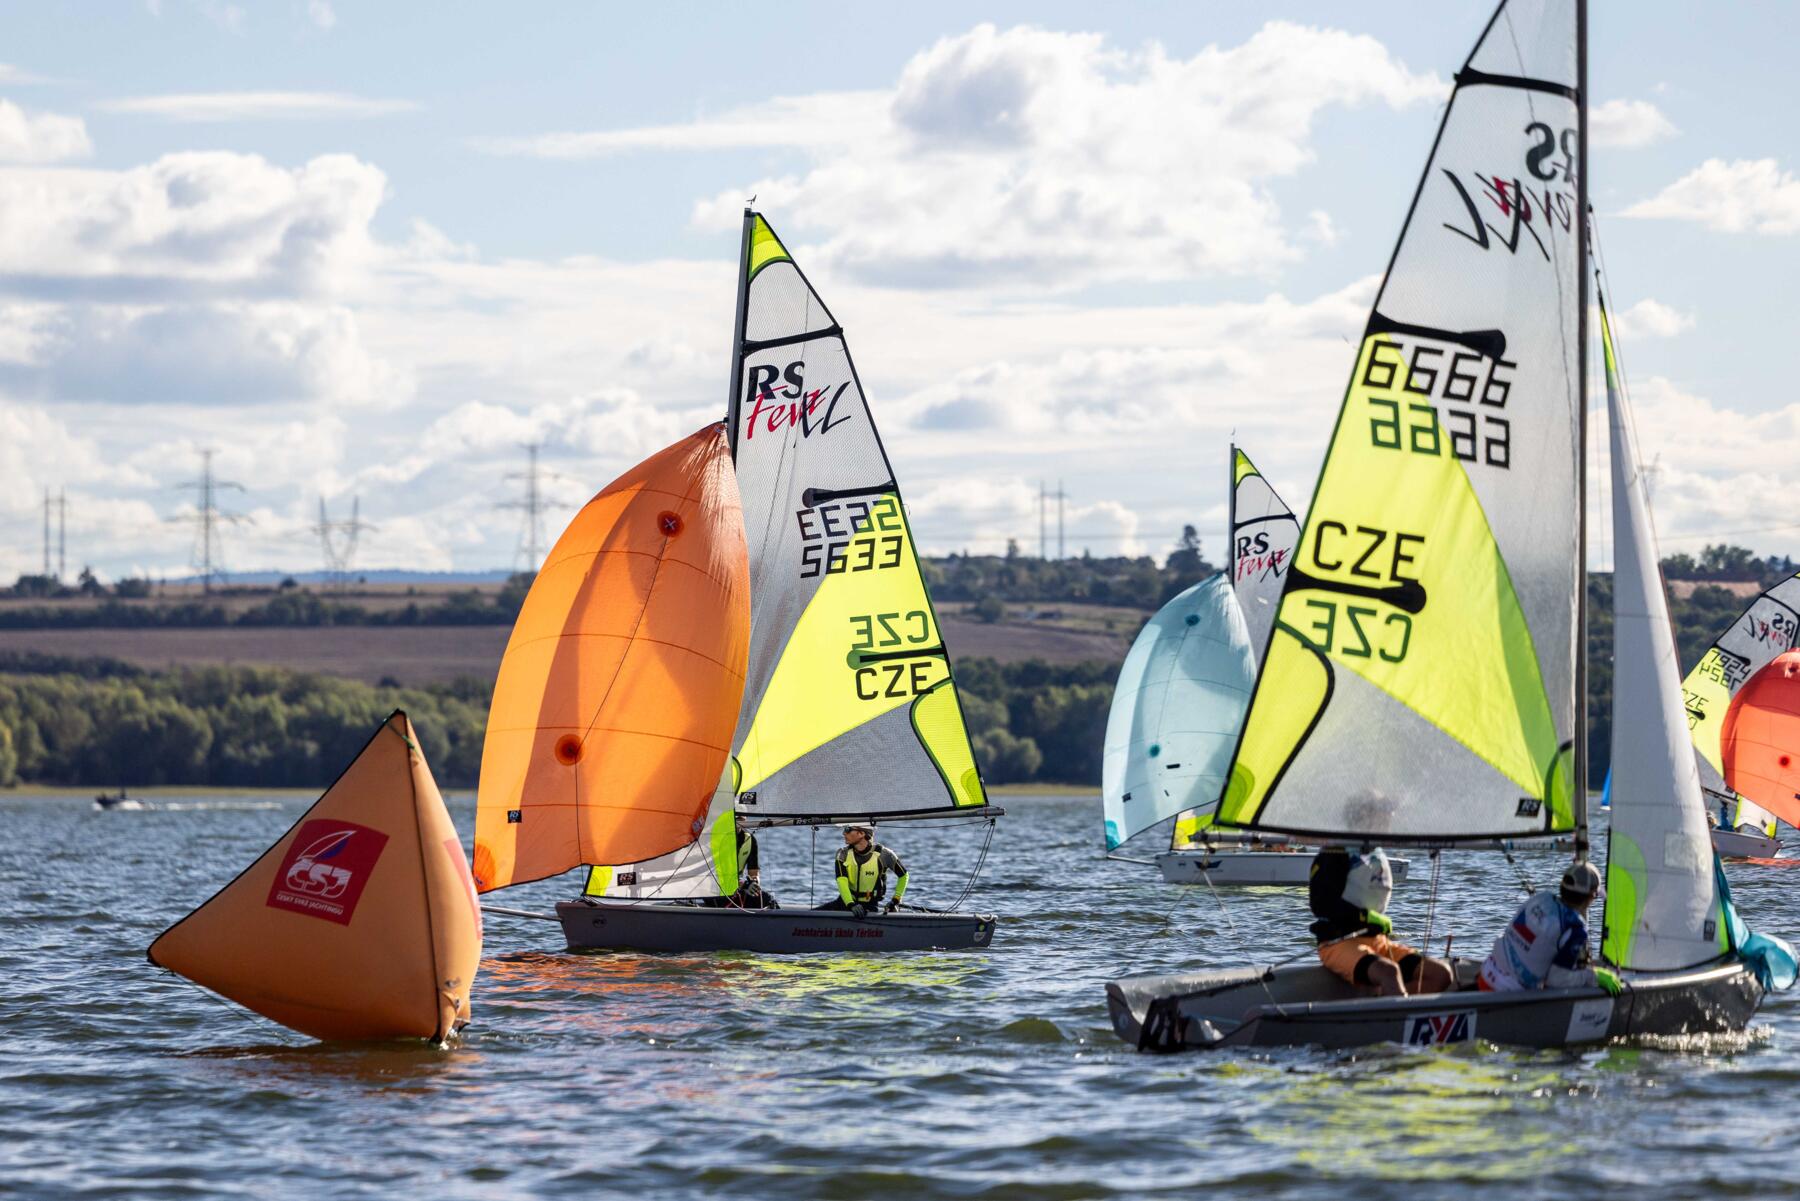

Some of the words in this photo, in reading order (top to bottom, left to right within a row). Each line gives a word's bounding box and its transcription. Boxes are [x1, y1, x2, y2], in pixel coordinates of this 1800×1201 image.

[746, 360, 805, 402] RS
[1362, 339, 1517, 409] 6666
[800, 536, 903, 578] 5633
[1237, 532, 1269, 559] RS
[1312, 520, 1425, 583] CZE
[855, 662, 934, 700] CZE
[1409, 1013, 1469, 1046] RYA
